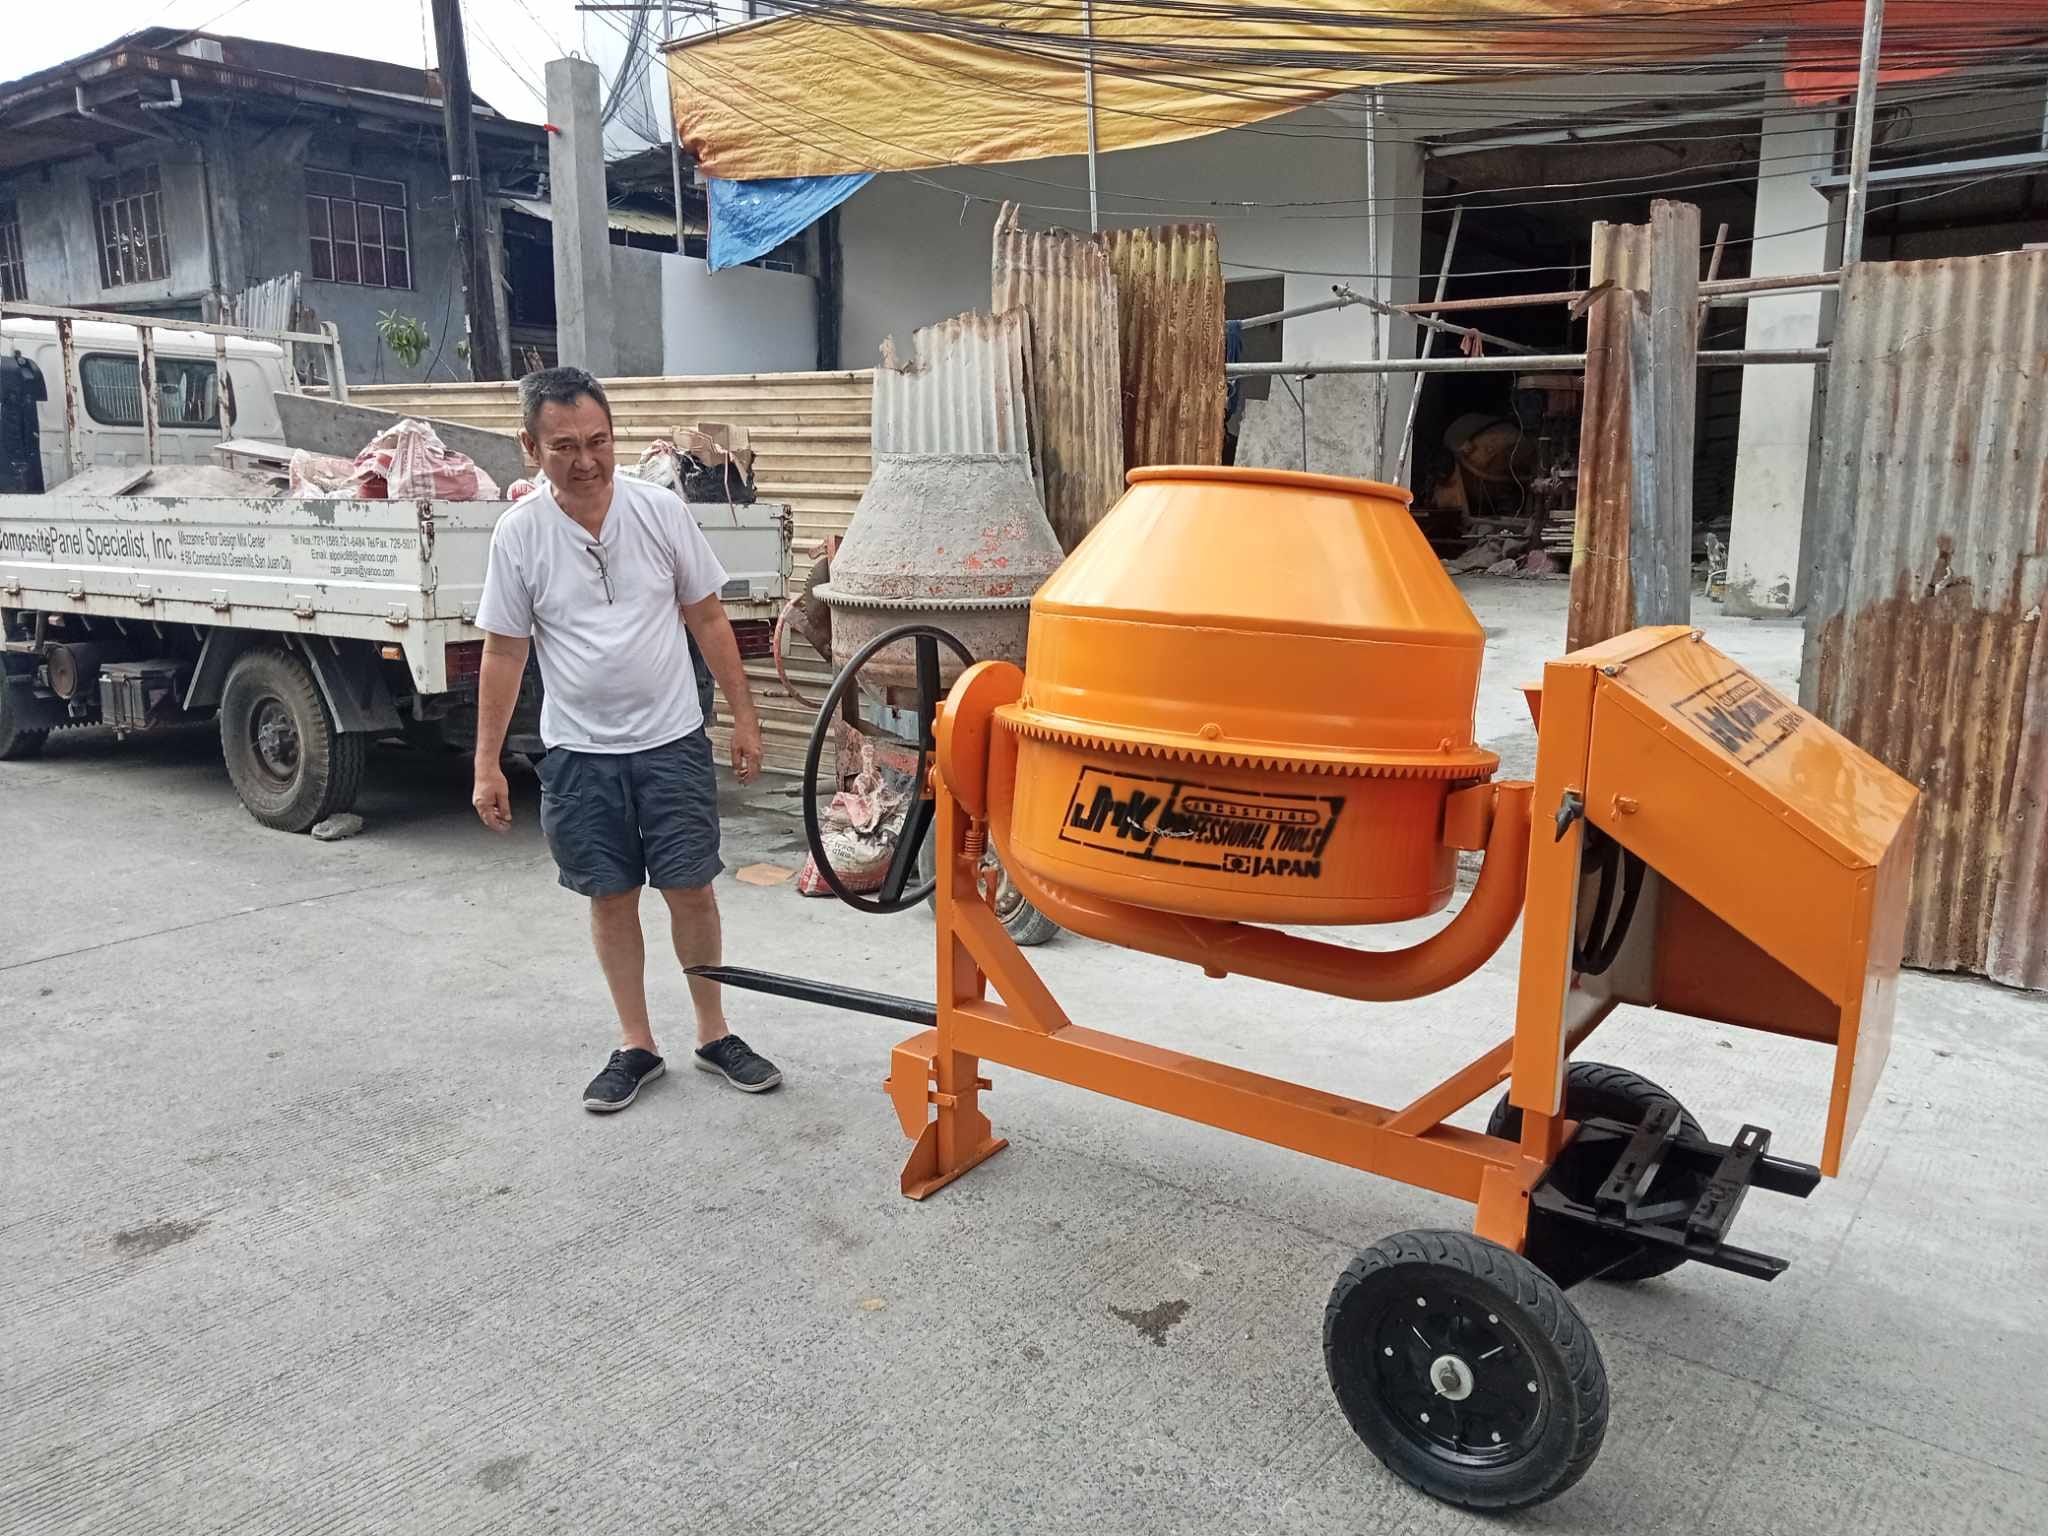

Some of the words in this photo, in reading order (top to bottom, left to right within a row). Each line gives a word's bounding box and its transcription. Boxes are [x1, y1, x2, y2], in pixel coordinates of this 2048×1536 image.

[86, 527, 149, 562] Specialist,
[152, 531, 177, 560] Inc.
[1251, 856, 1321, 878] JAPAN
